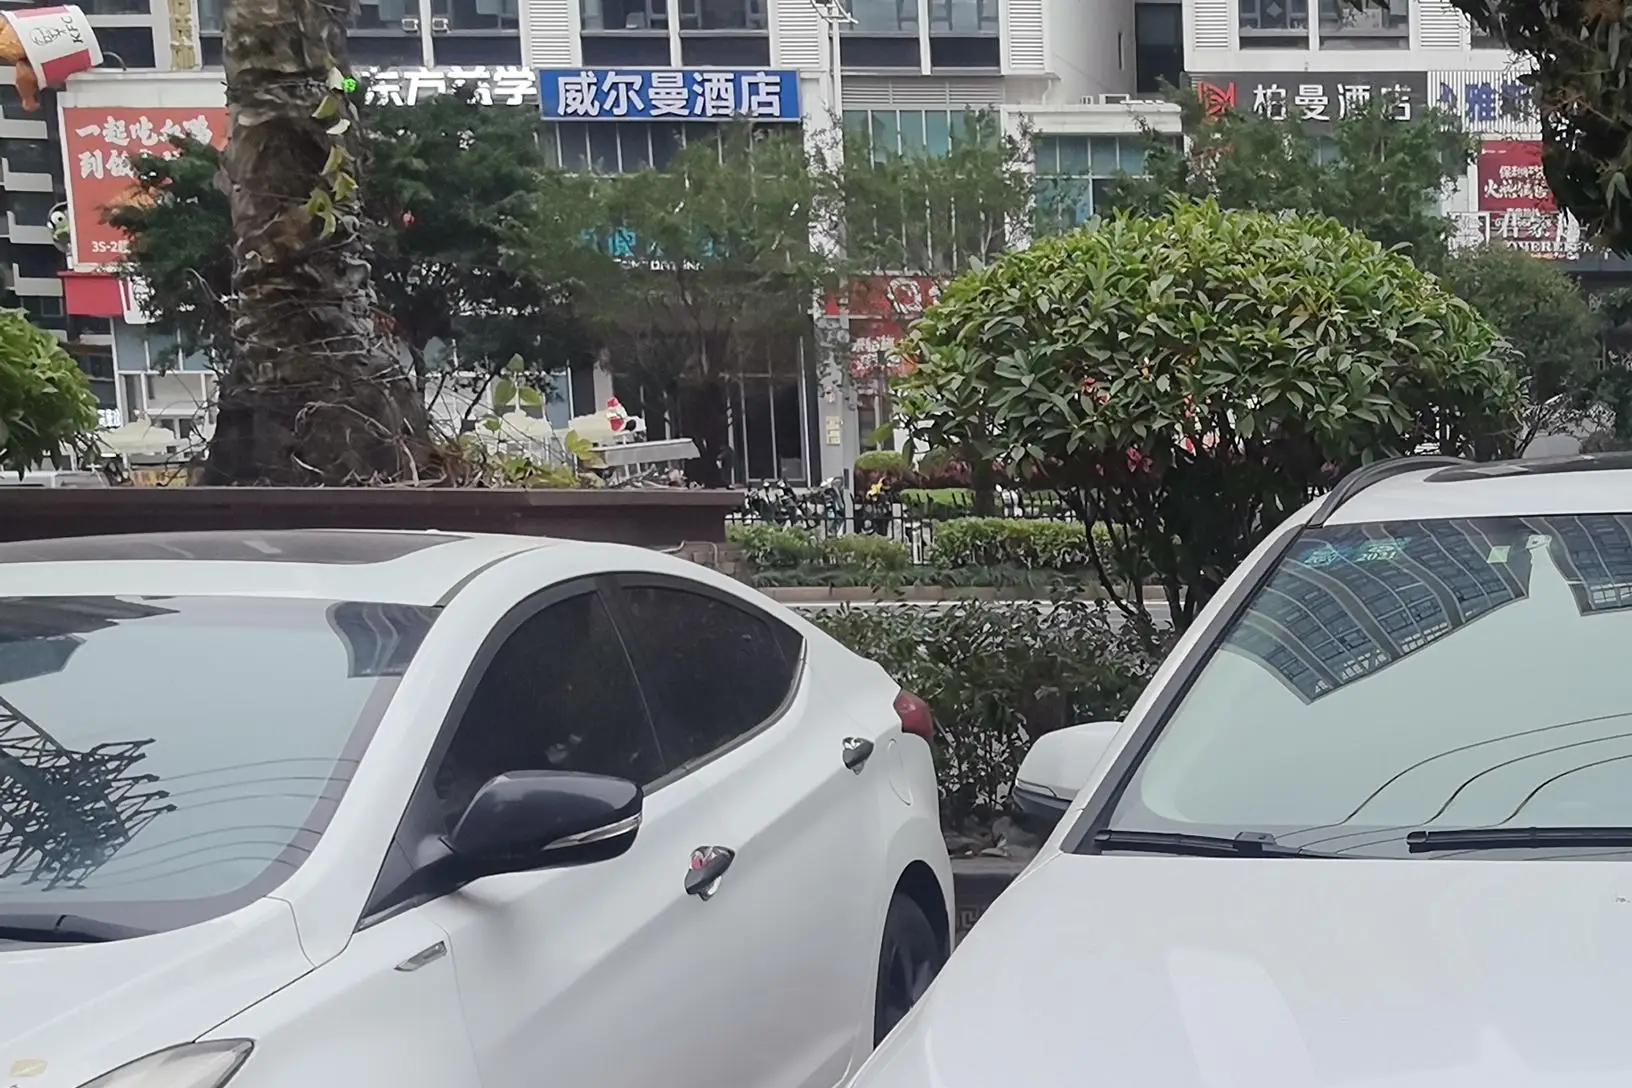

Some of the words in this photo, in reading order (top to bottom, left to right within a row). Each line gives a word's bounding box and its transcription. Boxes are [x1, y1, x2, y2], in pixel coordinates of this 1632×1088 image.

[61, 15, 83, 43] KFC
[557, 71, 781, 117] 威尔曼酒店
[1253, 83, 1412, 121] 柏曼酒店
